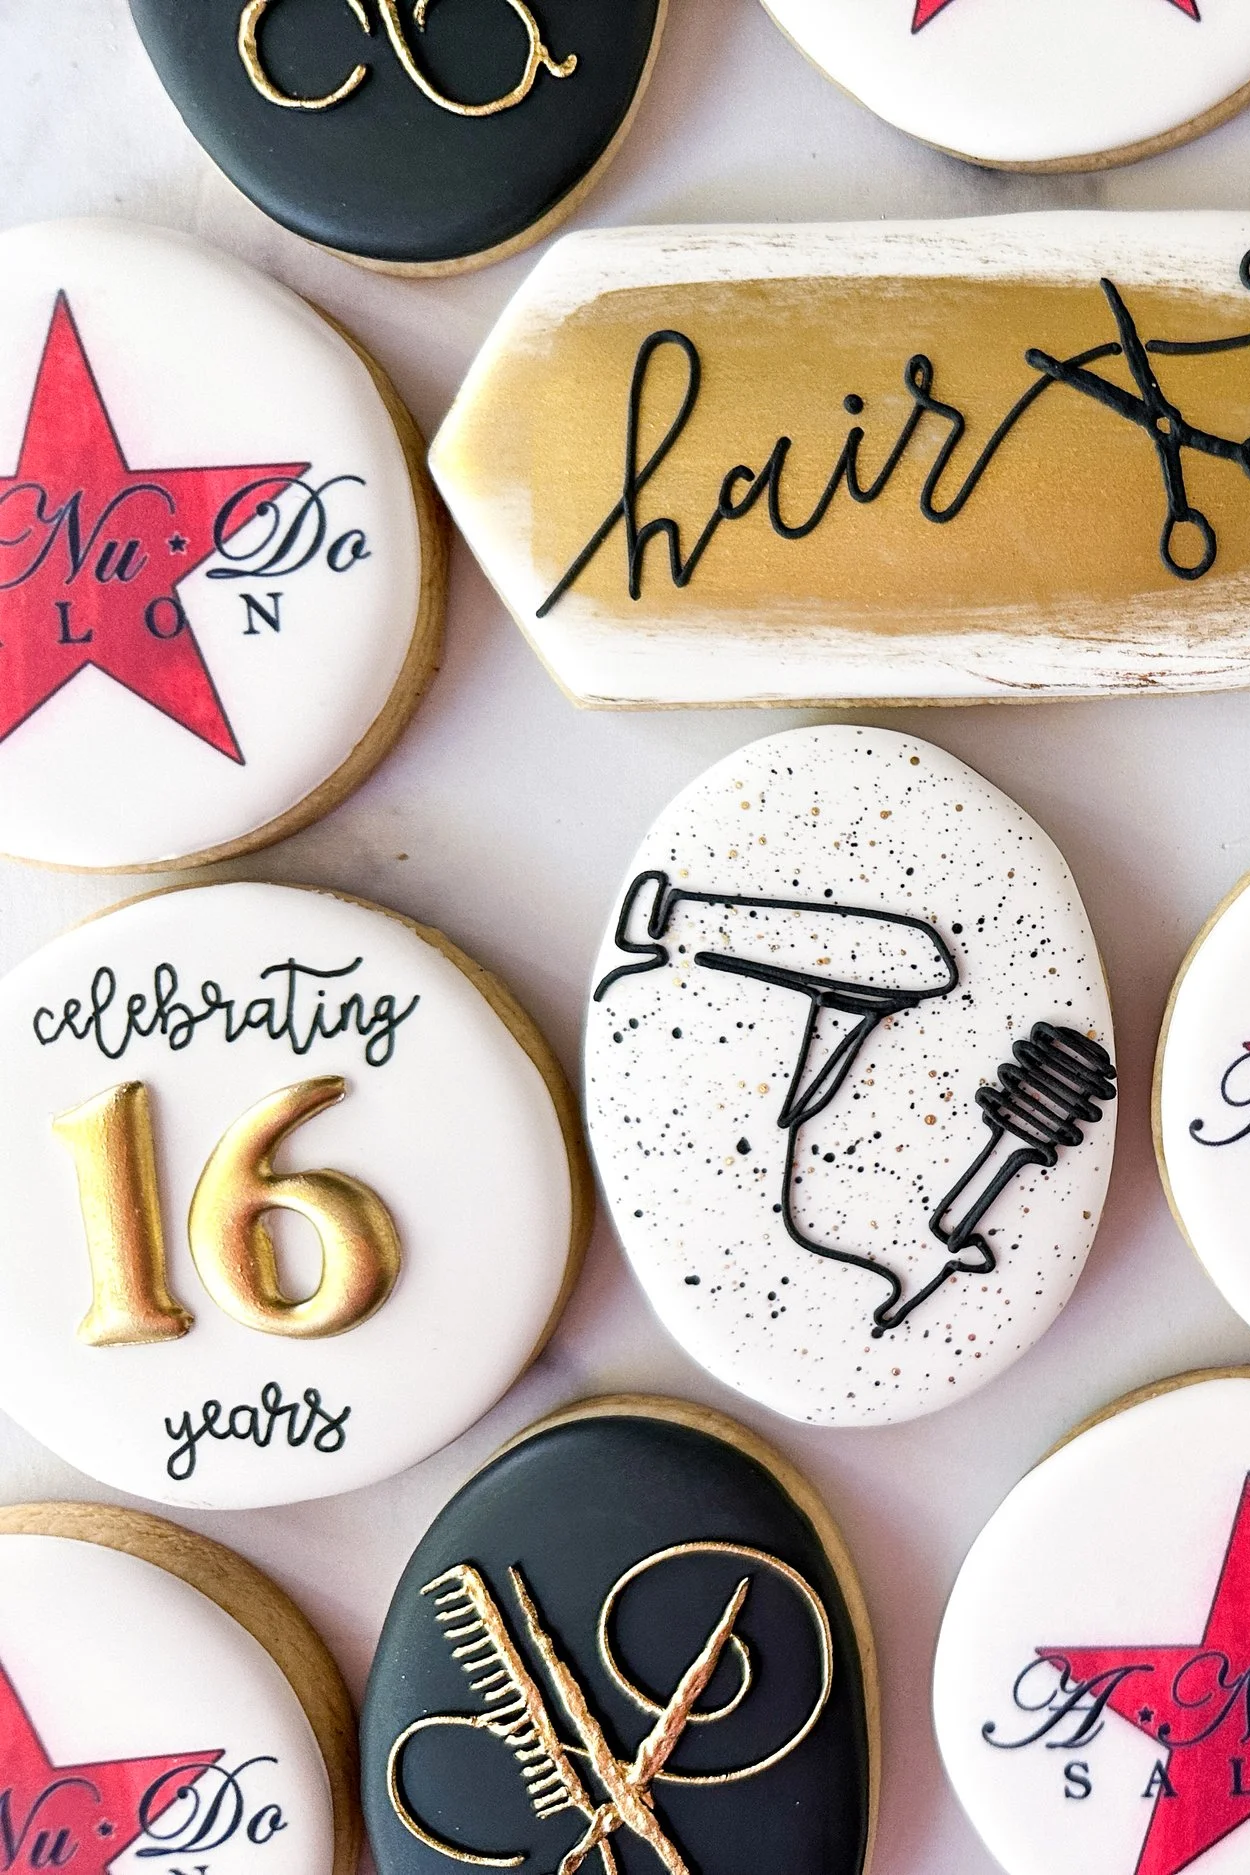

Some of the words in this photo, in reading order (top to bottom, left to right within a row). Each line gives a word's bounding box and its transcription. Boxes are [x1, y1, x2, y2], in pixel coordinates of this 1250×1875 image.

[536, 328, 1050, 617] hair
[205, 475, 371, 580] Do
[0, 592, 284, 644] LON
[33, 957, 421, 1067] celebrating
[51, 1073, 401, 1347] 16
[163, 1380, 352, 1481] years
[135, 1756, 288, 1858] Do
